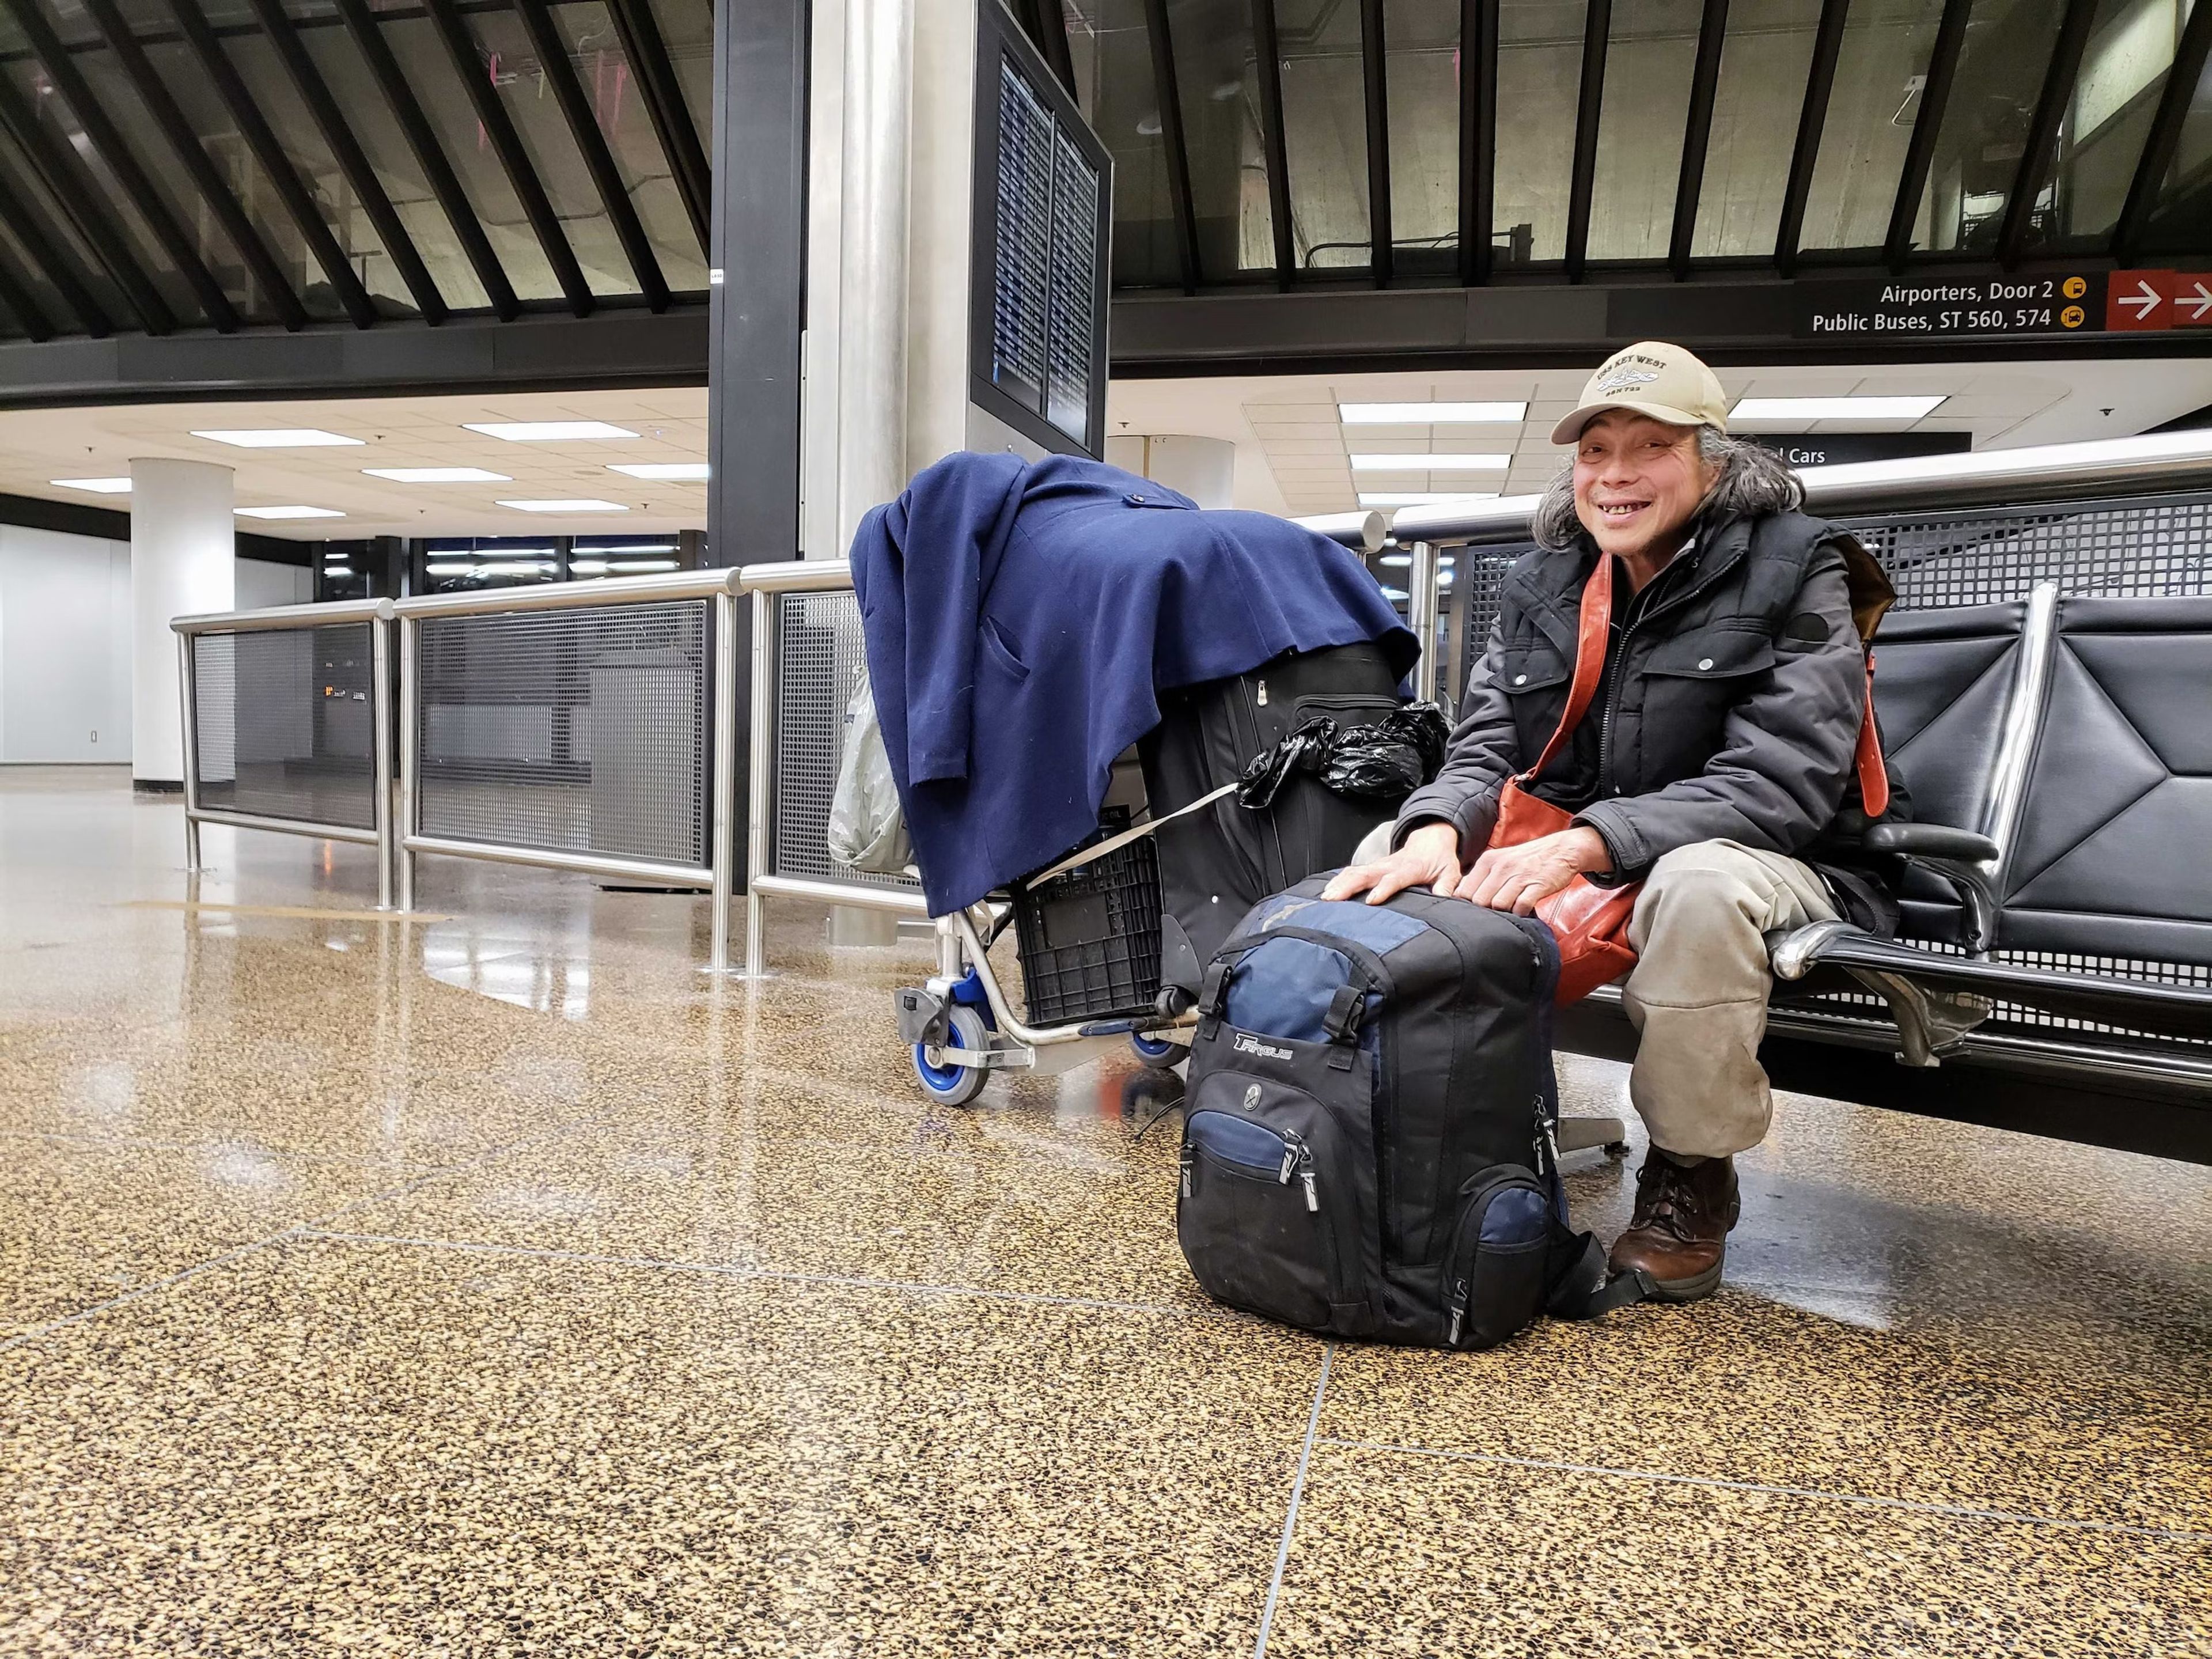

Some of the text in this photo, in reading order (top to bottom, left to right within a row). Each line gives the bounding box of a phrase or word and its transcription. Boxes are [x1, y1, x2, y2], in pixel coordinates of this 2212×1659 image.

[1880, 281, 2053, 306] Airporters, Door 2
[1813, 309, 2051, 331] Public Buses, ST 560, 574
[1597, 355, 1666, 380] USS KEY WEST
[1789, 448, 1825, 464] Cars
